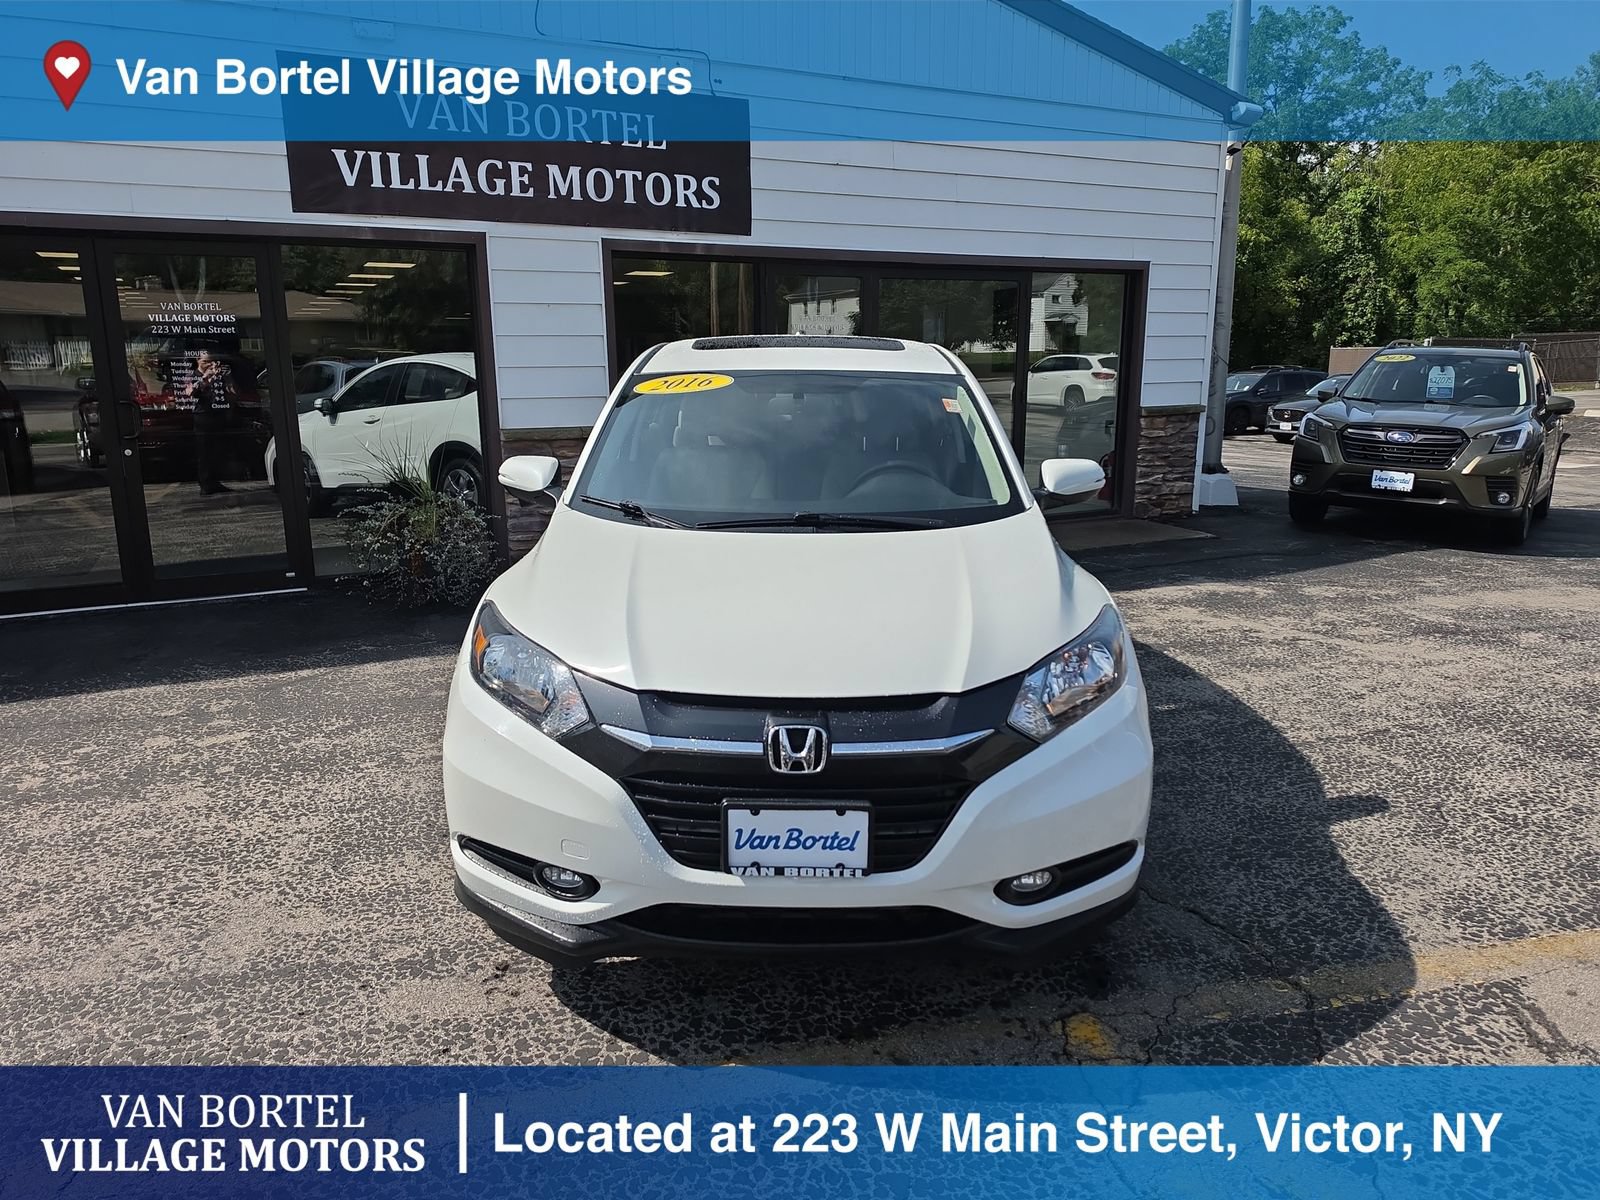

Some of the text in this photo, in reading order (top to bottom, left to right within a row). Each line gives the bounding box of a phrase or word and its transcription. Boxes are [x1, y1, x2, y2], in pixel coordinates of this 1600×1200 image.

[393, 90, 667, 150] VAN BORTEL
[331, 148, 721, 210] VILLAGE MOTORS
[160, 302, 222, 311] VAN BORTEL
[148, 313, 236, 323] VILLAGE MOTORS
[151, 325, 236, 334] 223 W Main Street
[648, 377, 713, 392] 2016
[734, 827, 861, 852] Van Bortel
[730, 866, 865, 879] VAN BORTEL
